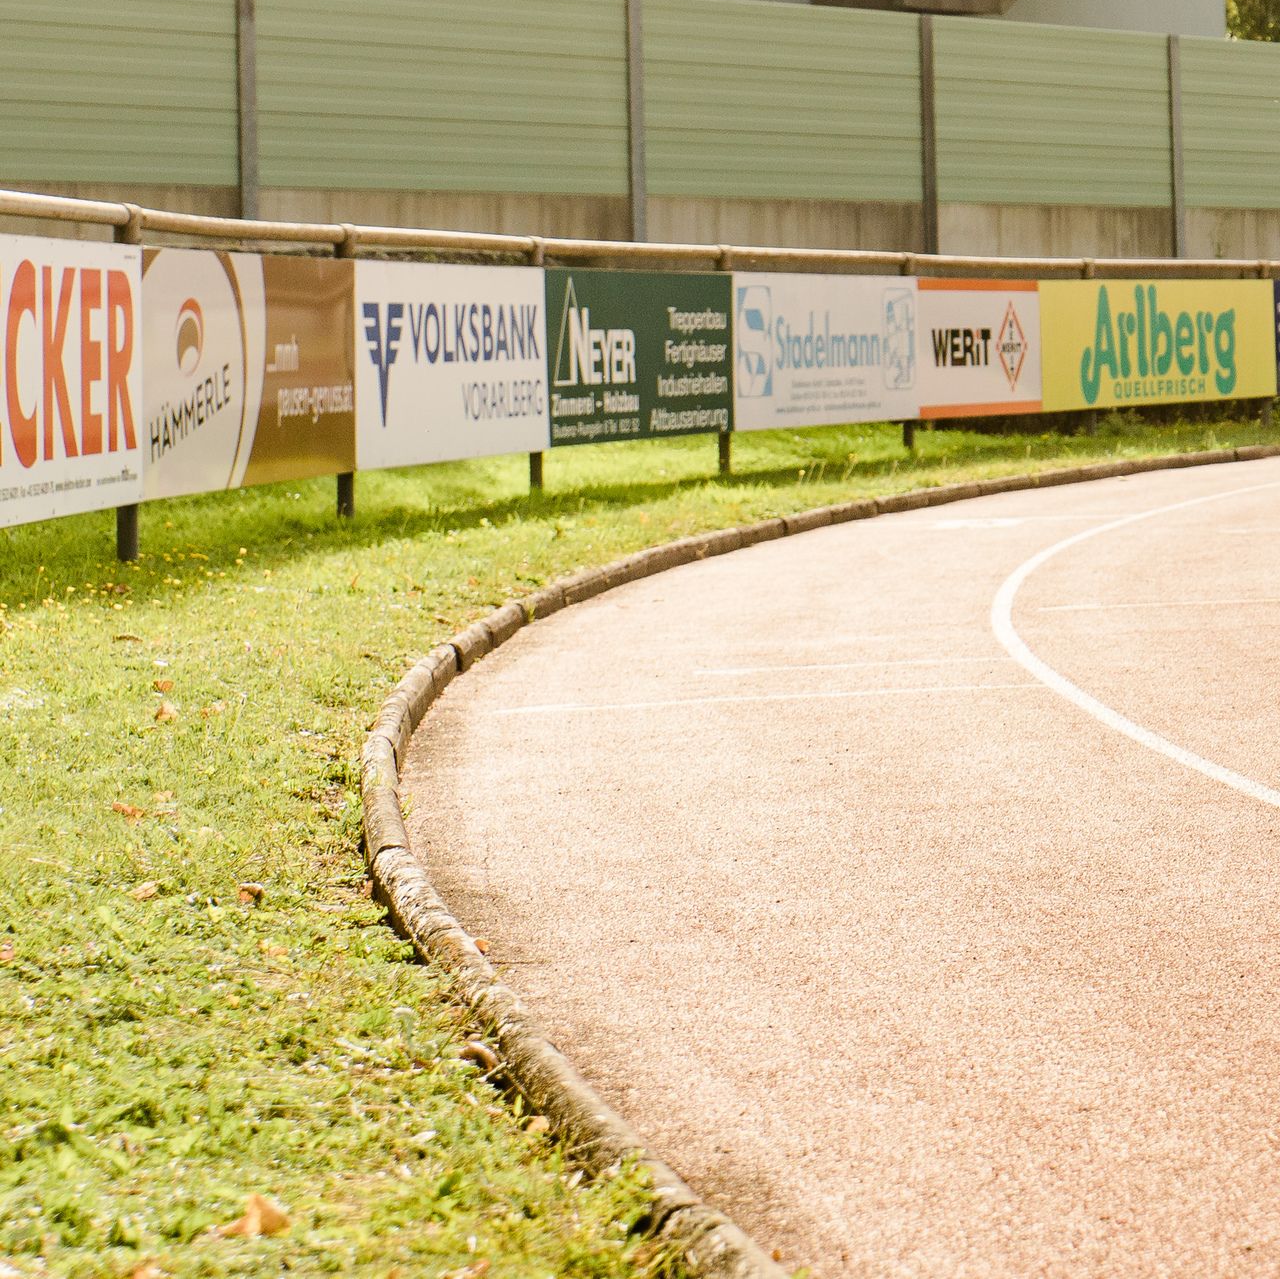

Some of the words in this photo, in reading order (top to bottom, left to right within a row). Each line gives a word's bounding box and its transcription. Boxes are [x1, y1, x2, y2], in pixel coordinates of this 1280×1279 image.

[409, 303, 541, 364] VOLKSBANK
[666, 306, 727, 333] Treppenbau
[775, 310, 881, 371] Stadelmann
[1080, 283, 1236, 405] Arlberg
[149, 362, 232, 464] HÄMMERLE
[462, 379, 543, 420] VORARLBERG
[1113, 377, 1207, 400] QUELLFRISCH
